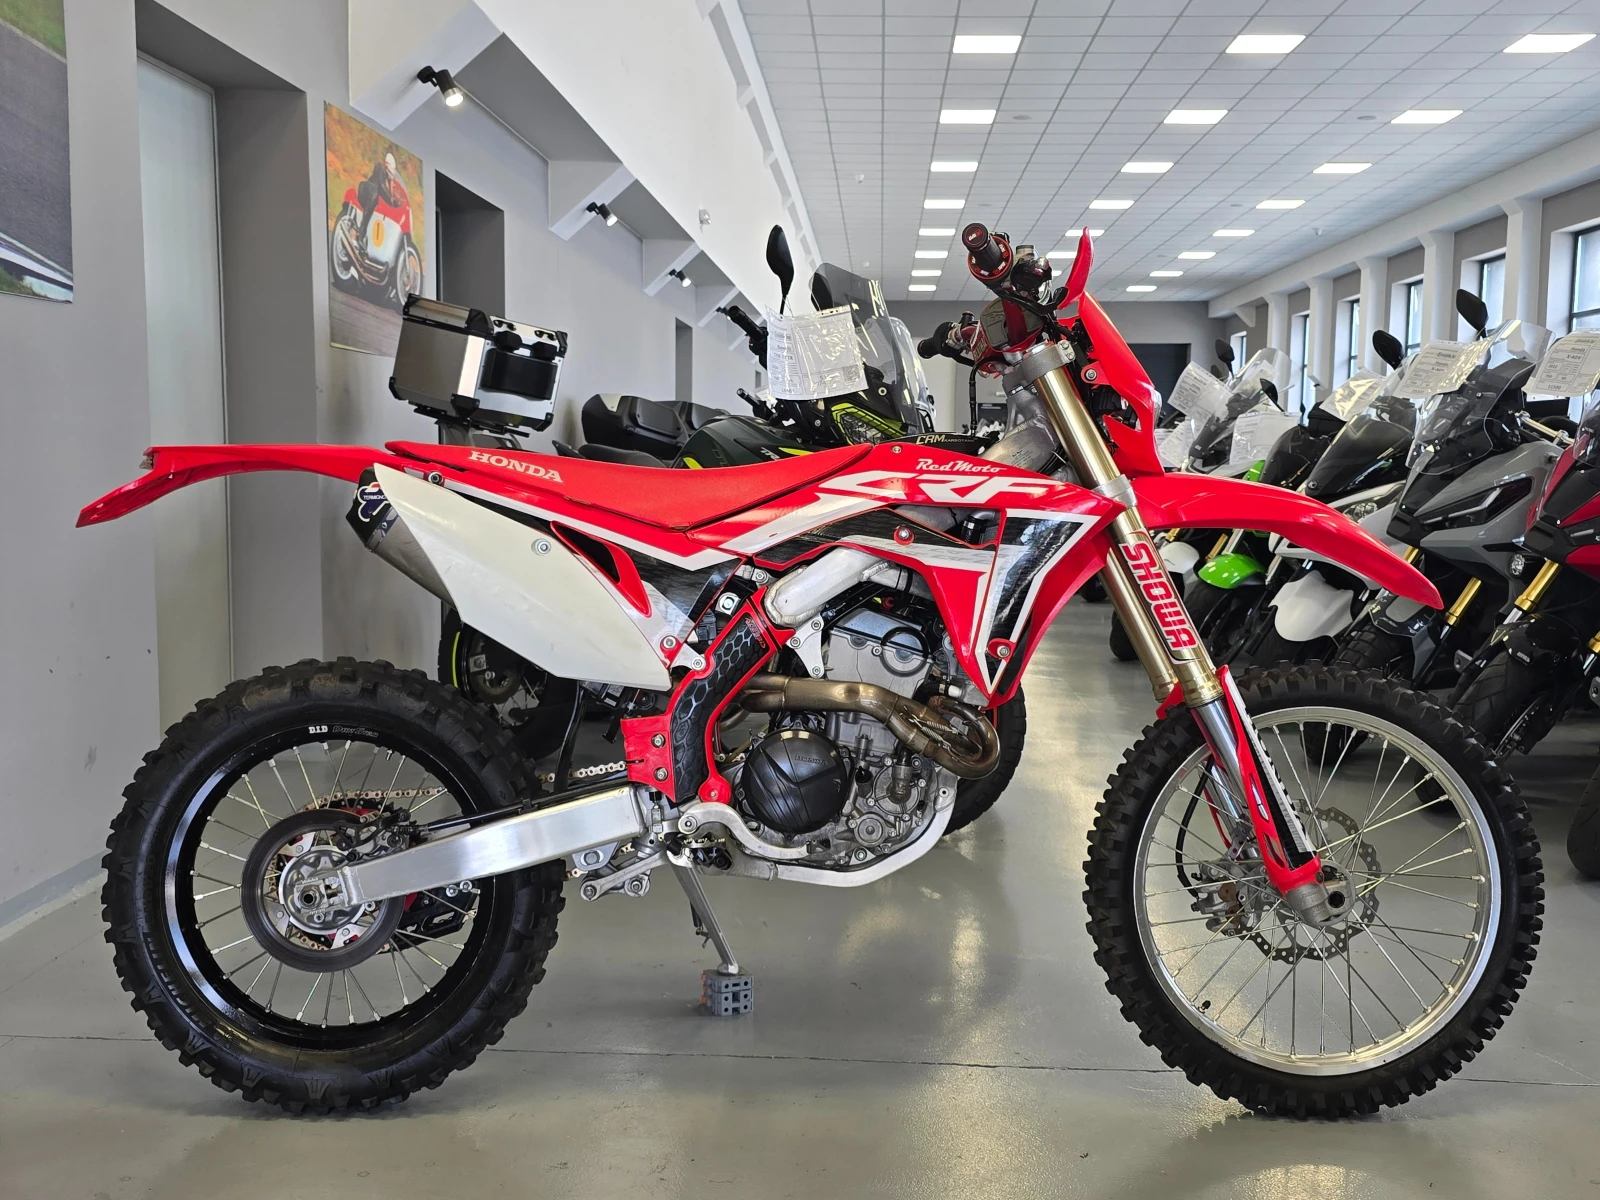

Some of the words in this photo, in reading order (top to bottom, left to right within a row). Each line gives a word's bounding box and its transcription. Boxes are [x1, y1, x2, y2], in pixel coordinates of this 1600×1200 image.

[916, 434, 947, 445] CRM
[468, 451, 563, 483] HONDA
[820, 470, 1063, 504] CRF
[1119, 542, 1199, 649] SHOWA
[146, 934, 208, 1028] MICHELIN
